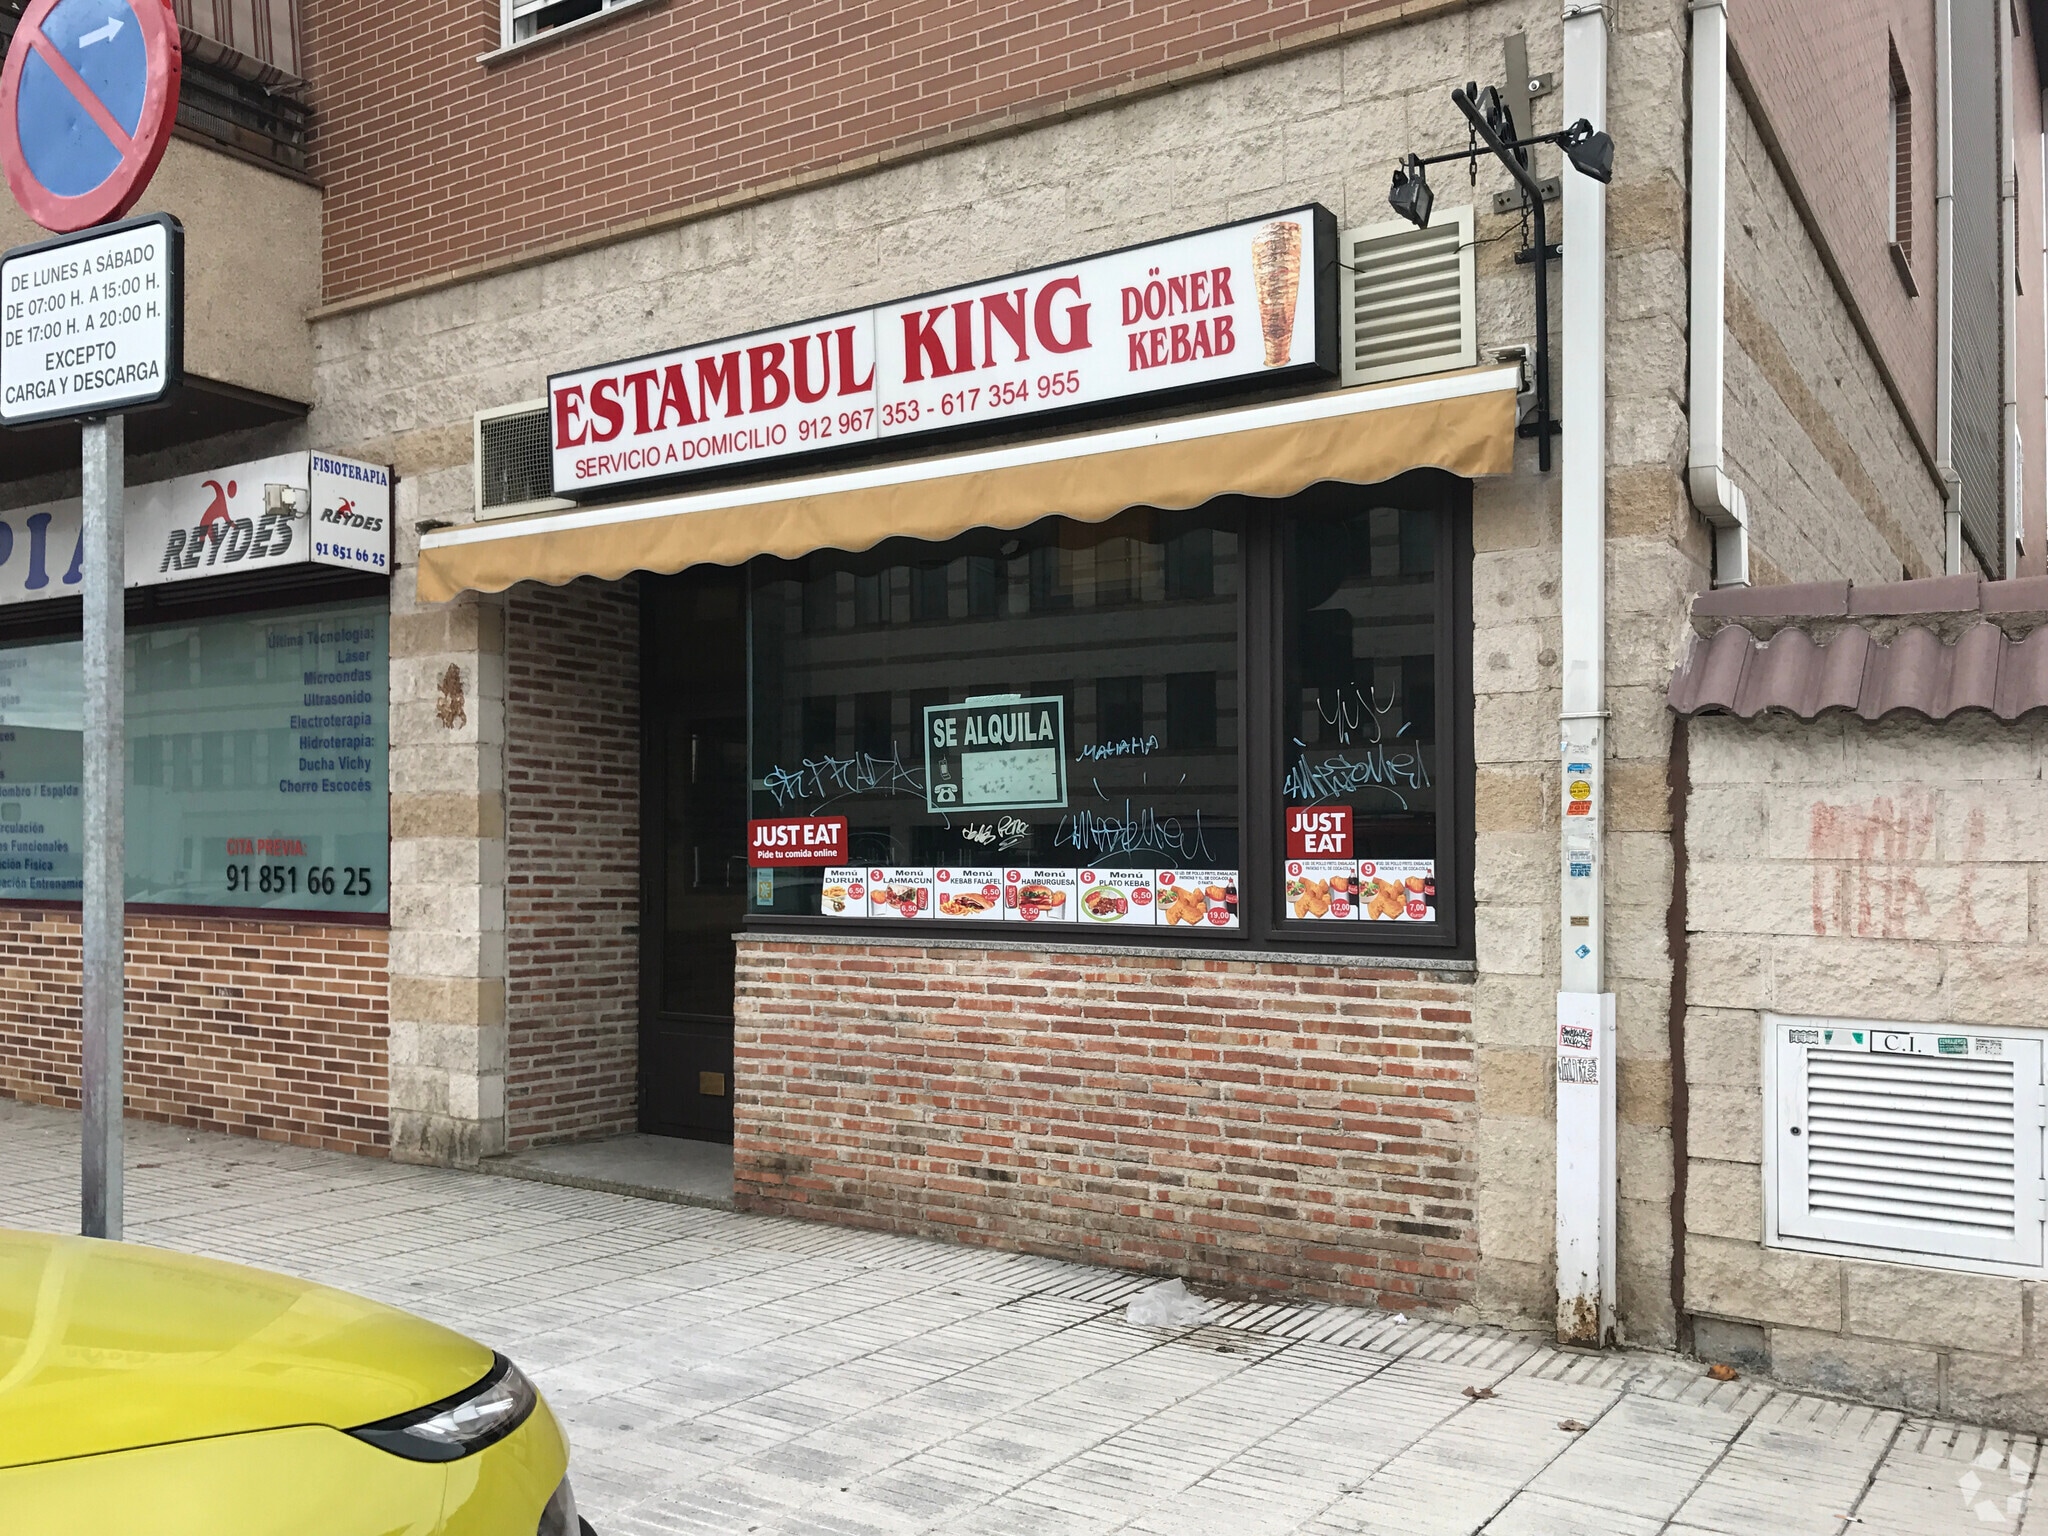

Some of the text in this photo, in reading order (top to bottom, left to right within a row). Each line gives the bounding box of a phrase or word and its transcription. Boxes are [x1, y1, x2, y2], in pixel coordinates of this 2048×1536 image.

[11, 243, 155, 293] DE LUNES A SÁBADO
[6, 272, 160, 321] DE 07:00 H. A 15:00 H.
[1120, 266, 1235, 327] DÖNER
[5, 301, 161, 348] DE 17:00 H. A 20:00 H.
[1127, 314, 1236, 373] KEBAB
[45, 341, 117, 372] EXCEPTO
[553, 274, 1093, 450] ESTAMBUL KING
[5, 360, 160, 404] CARGA Y DESCARGA
[575, 445, 661, 480] SERVICIO
[664, 443, 679, 464] A
[682, 423, 787, 462] DOMICILIO
[798, 415, 832, 442] 912
[837, 407, 875, 435] 967
[882, 398, 920, 427] 353
[940, 387, 980, 415] 617
[988, 378, 1028, 408] 354
[1037, 370, 1081, 400] 955
[313, 456, 388, 487] FISIOTERAPIA
[320, 508, 384, 532] REYDES
[159, 512, 297, 574] REYDES
[315, 542, 386, 568] 91 851 66 25
[304, 668, 372, 685] Microondas
[303, 690, 372, 707] Ultrasonido
[290, 712, 372, 730] Electroterapia
[933, 710, 1055, 749] SE ALQUILA
[299, 733, 375, 751] Hidroterapia:
[299, 756, 371, 774] Ducha Vichy
[40, 784, 79, 800] Espalda
[279, 779, 318, 793] Chorro
[0, 820, 44, 834] rculación
[1291, 812, 1346, 833] JUST
[753, 823, 842, 847] JUST EAT
[1305, 833, 1347, 853] EAT
[226, 838, 308, 857] CITA PREVIA:
[757, 848, 838, 859] Pide tu comida online
[873, 871, 880, 880] 3
[939, 871, 947, 880] 4
[1010, 871, 1017, 881] 5
[1085, 872, 1092, 881] 6
[1163, 873, 1171, 882] 7
[1293, 865, 1299, 874] 8
[1366, 865, 1372, 874] 9
[30, 875, 83, 891] Entrenamie
[226, 864, 372, 897] 91 851 66 25
[1021, 878, 1076, 886] HAMBURGUESA
[1132, 891, 1152, 900] 6,50
[1021, 907, 1039, 915] 5,50
[1209, 911, 1230, 920] 19,00
[1409, 903, 1424, 911] 7,00
[1884, 1034, 1922, 1053] C.I.
